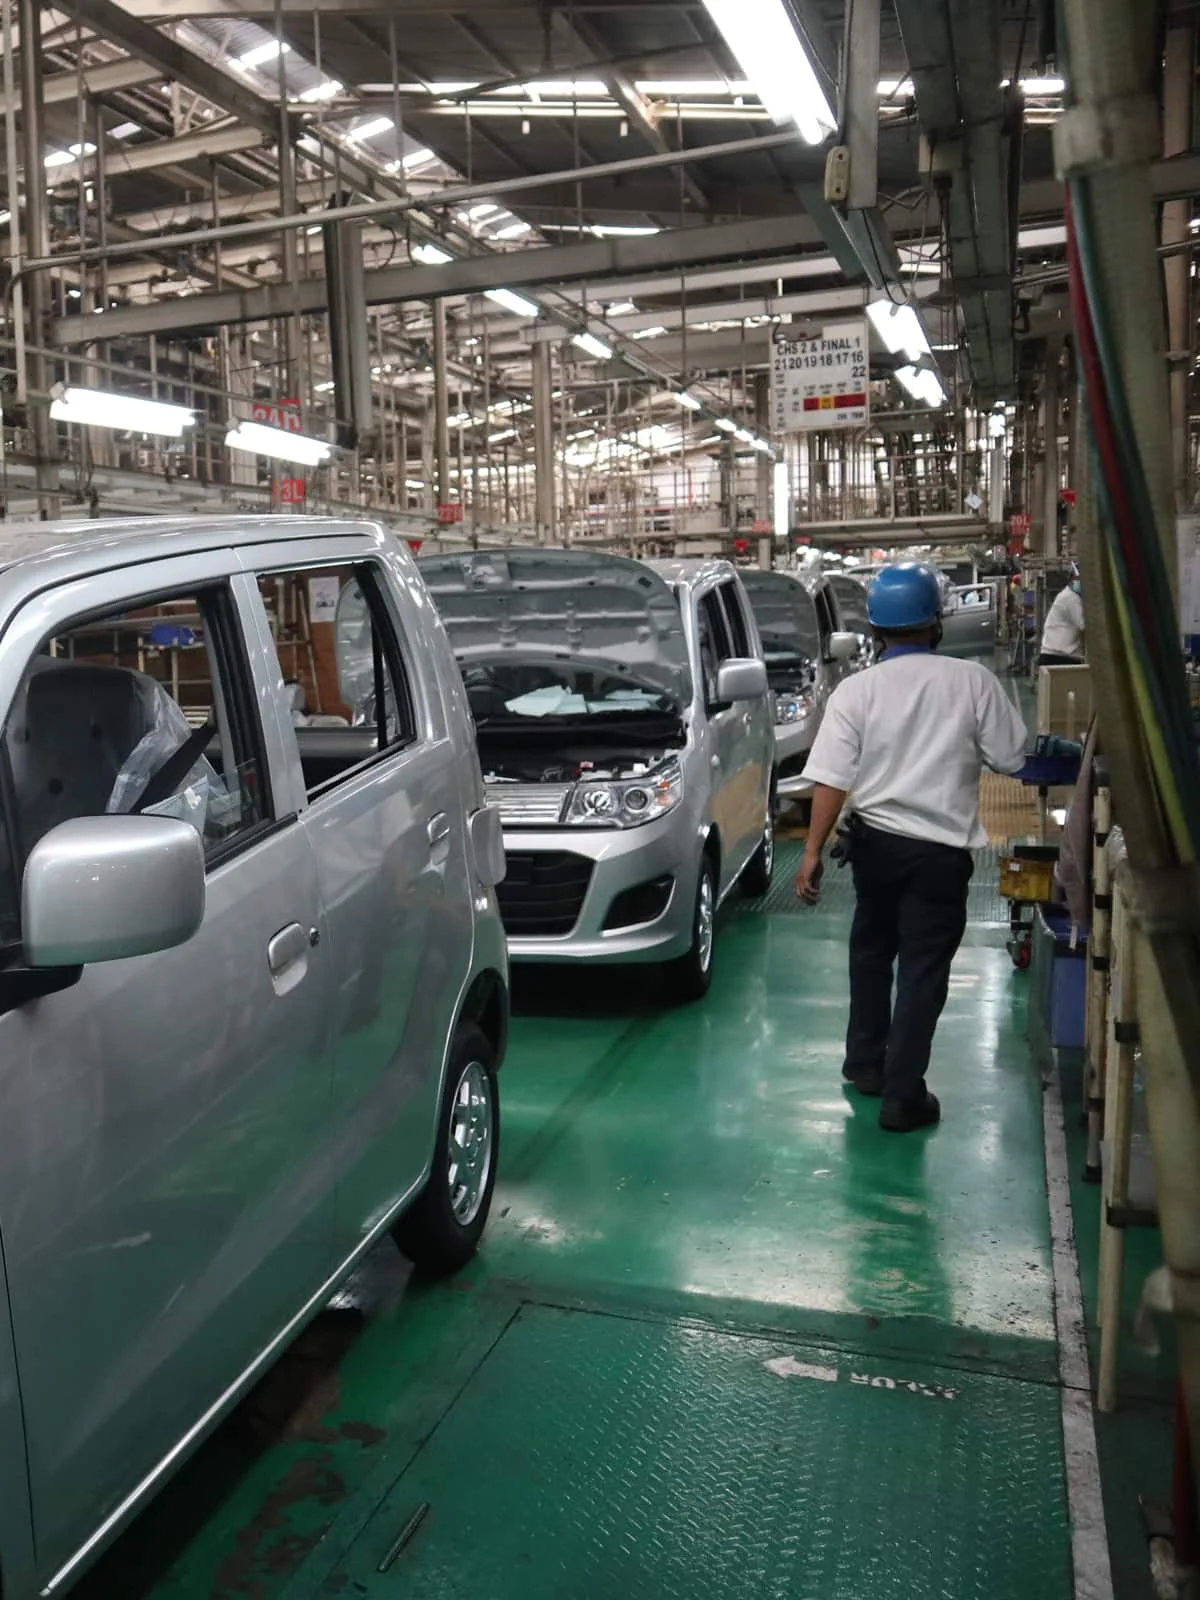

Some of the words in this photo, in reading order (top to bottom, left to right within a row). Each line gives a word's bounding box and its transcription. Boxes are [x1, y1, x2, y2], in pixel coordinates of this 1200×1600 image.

[777, 342, 799, 356] CHS
[801, 342, 807, 354] 2
[810, 341, 818, 353] &
[821, 338, 852, 351] FINAL
[855, 336, 860, 348] 1
[774, 358, 787, 370] 21
[789, 357, 802, 370] 20
[804, 355, 817, 367] 19
[820, 353, 833, 366] 18
[836, 352, 849, 365] 17
[851, 351, 864, 363] 16
[851, 366, 866, 378] 22
